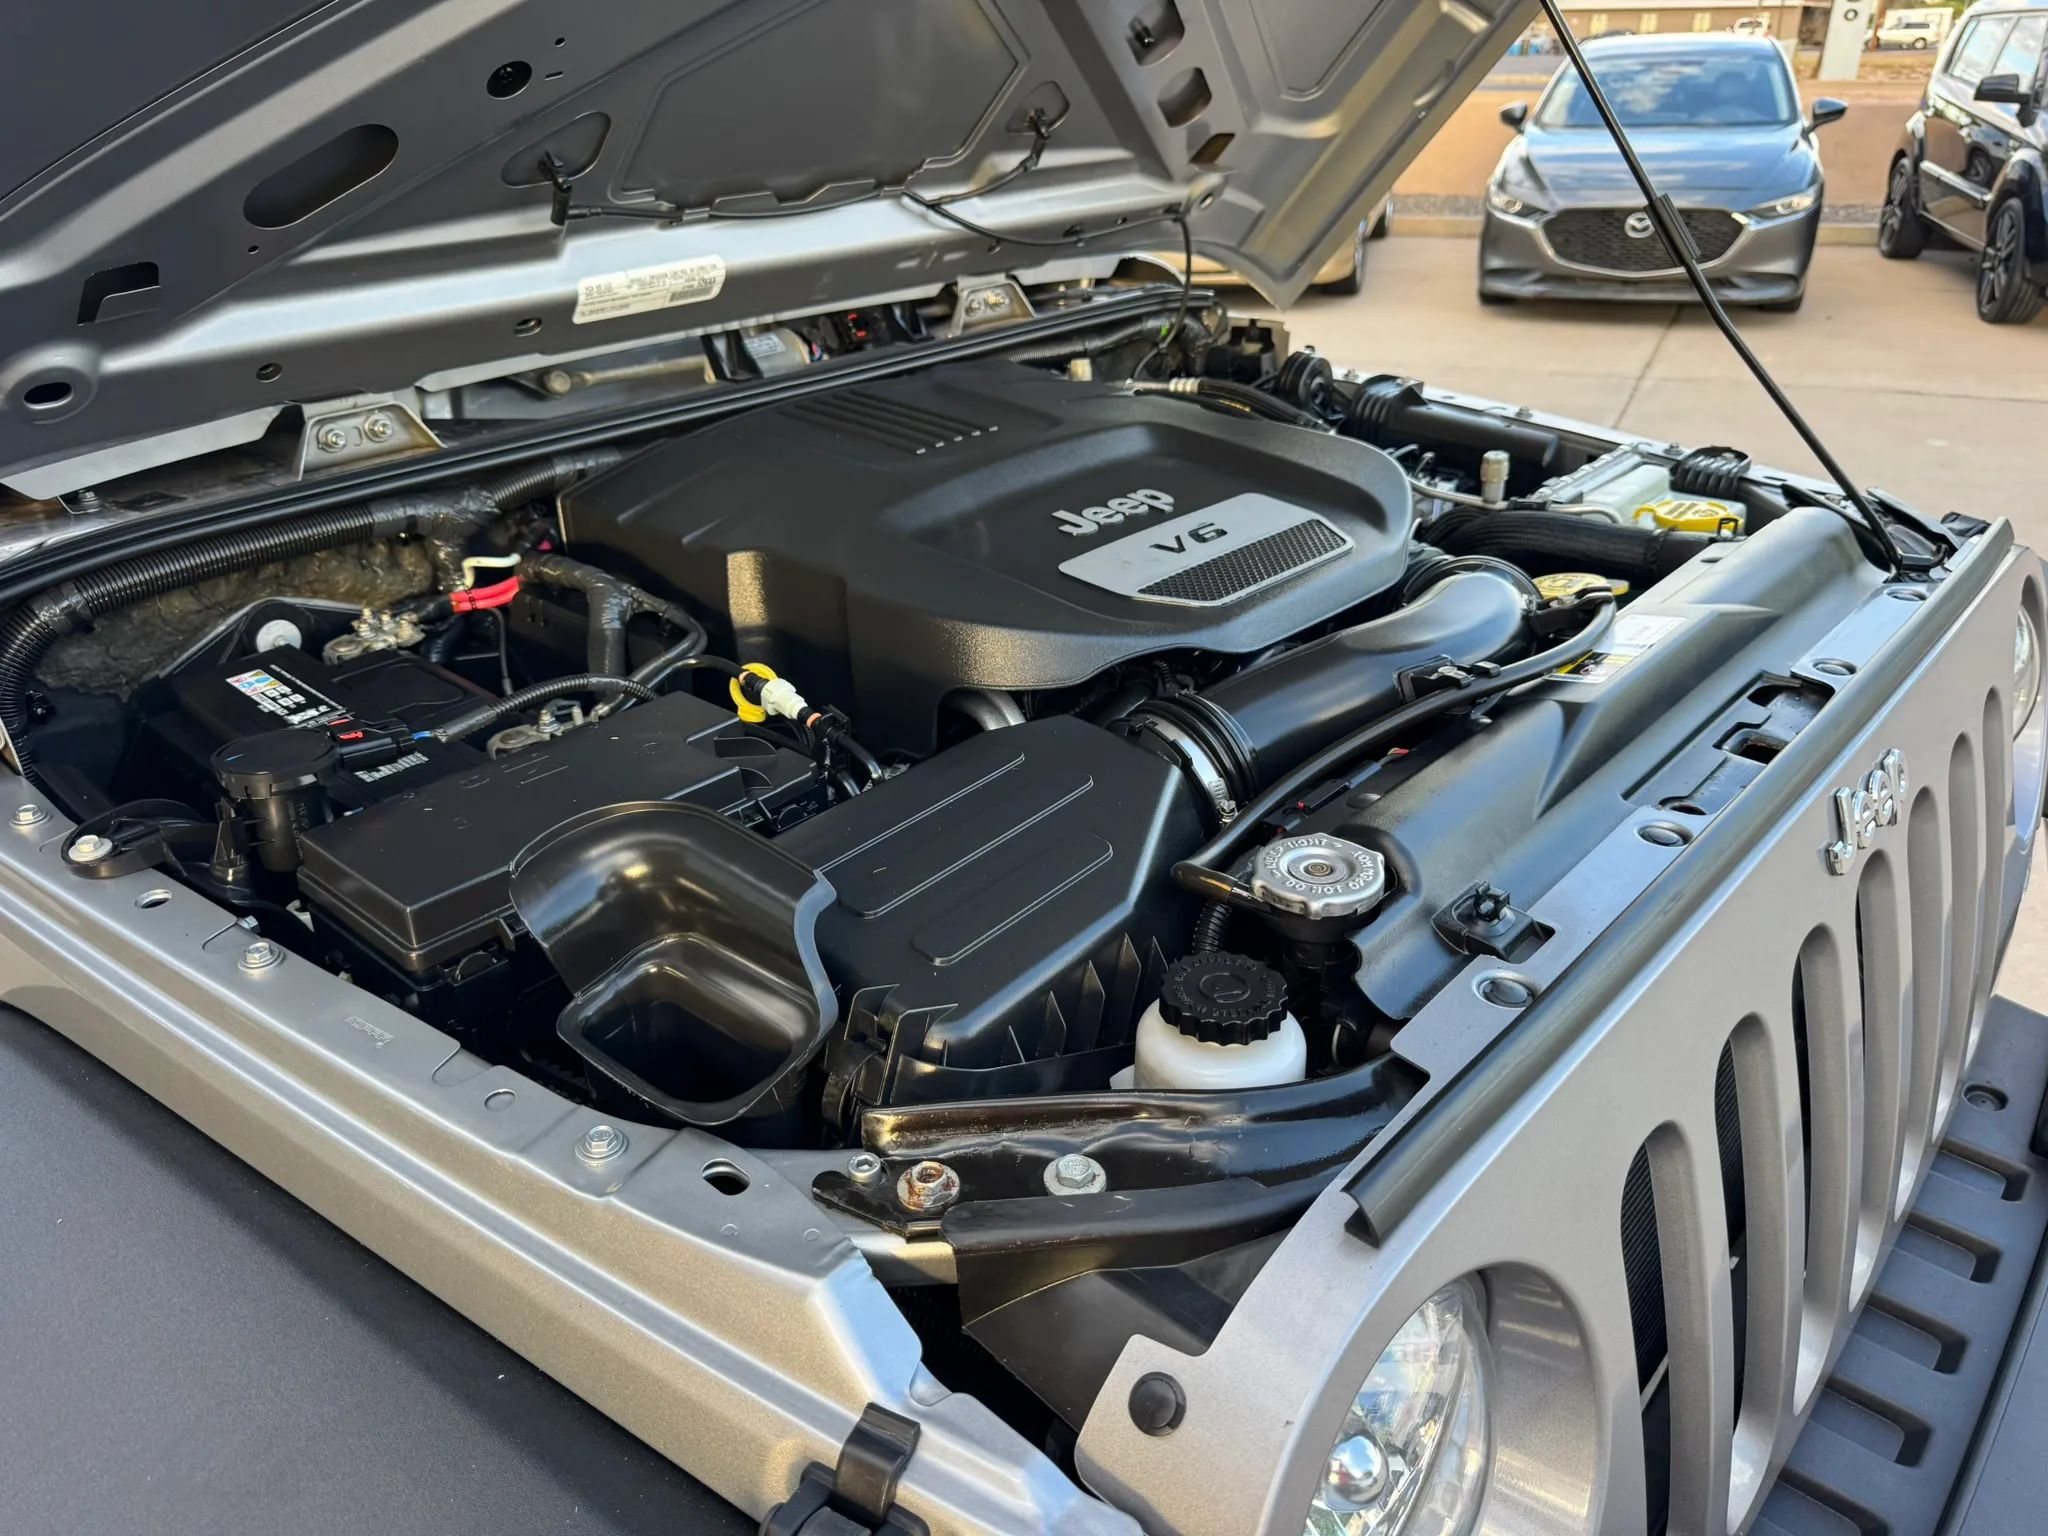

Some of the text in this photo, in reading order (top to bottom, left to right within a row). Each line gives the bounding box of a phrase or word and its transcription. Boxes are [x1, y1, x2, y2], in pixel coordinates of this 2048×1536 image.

[1051, 489, 1174, 536] Jeep
[1149, 522, 1228, 554] V6
[1825, 748, 1908, 876] Jeep
